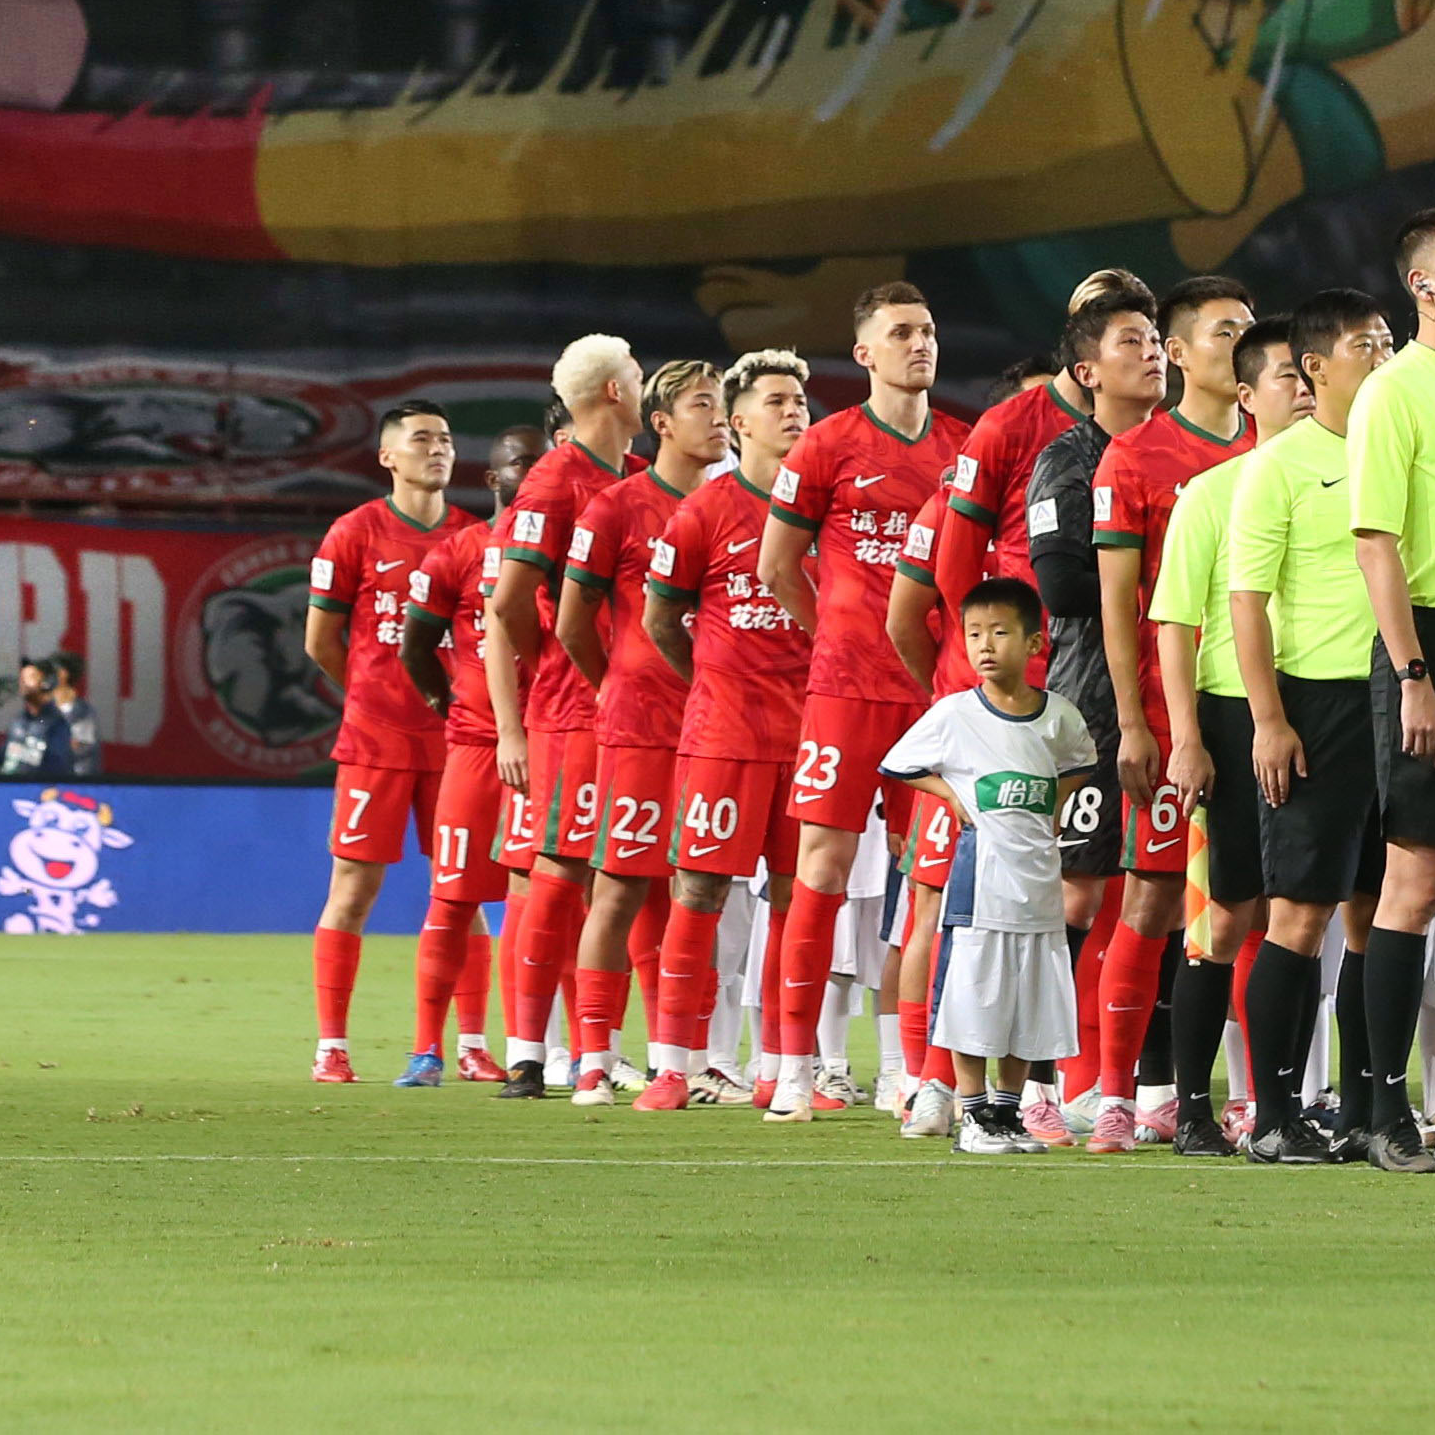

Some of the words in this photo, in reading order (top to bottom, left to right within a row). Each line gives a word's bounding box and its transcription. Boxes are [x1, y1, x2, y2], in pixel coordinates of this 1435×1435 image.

[793, 740, 841, 791] 23
[348, 789, 371, 830] 7
[575, 782, 597, 826] 9
[610, 796, 662, 845] 22
[684, 793, 739, 841] 40
[1060, 786, 1103, 833] 18
[1151, 785, 1179, 832] 6
[438, 825, 469, 869] 11
[925, 806, 951, 853] 4
